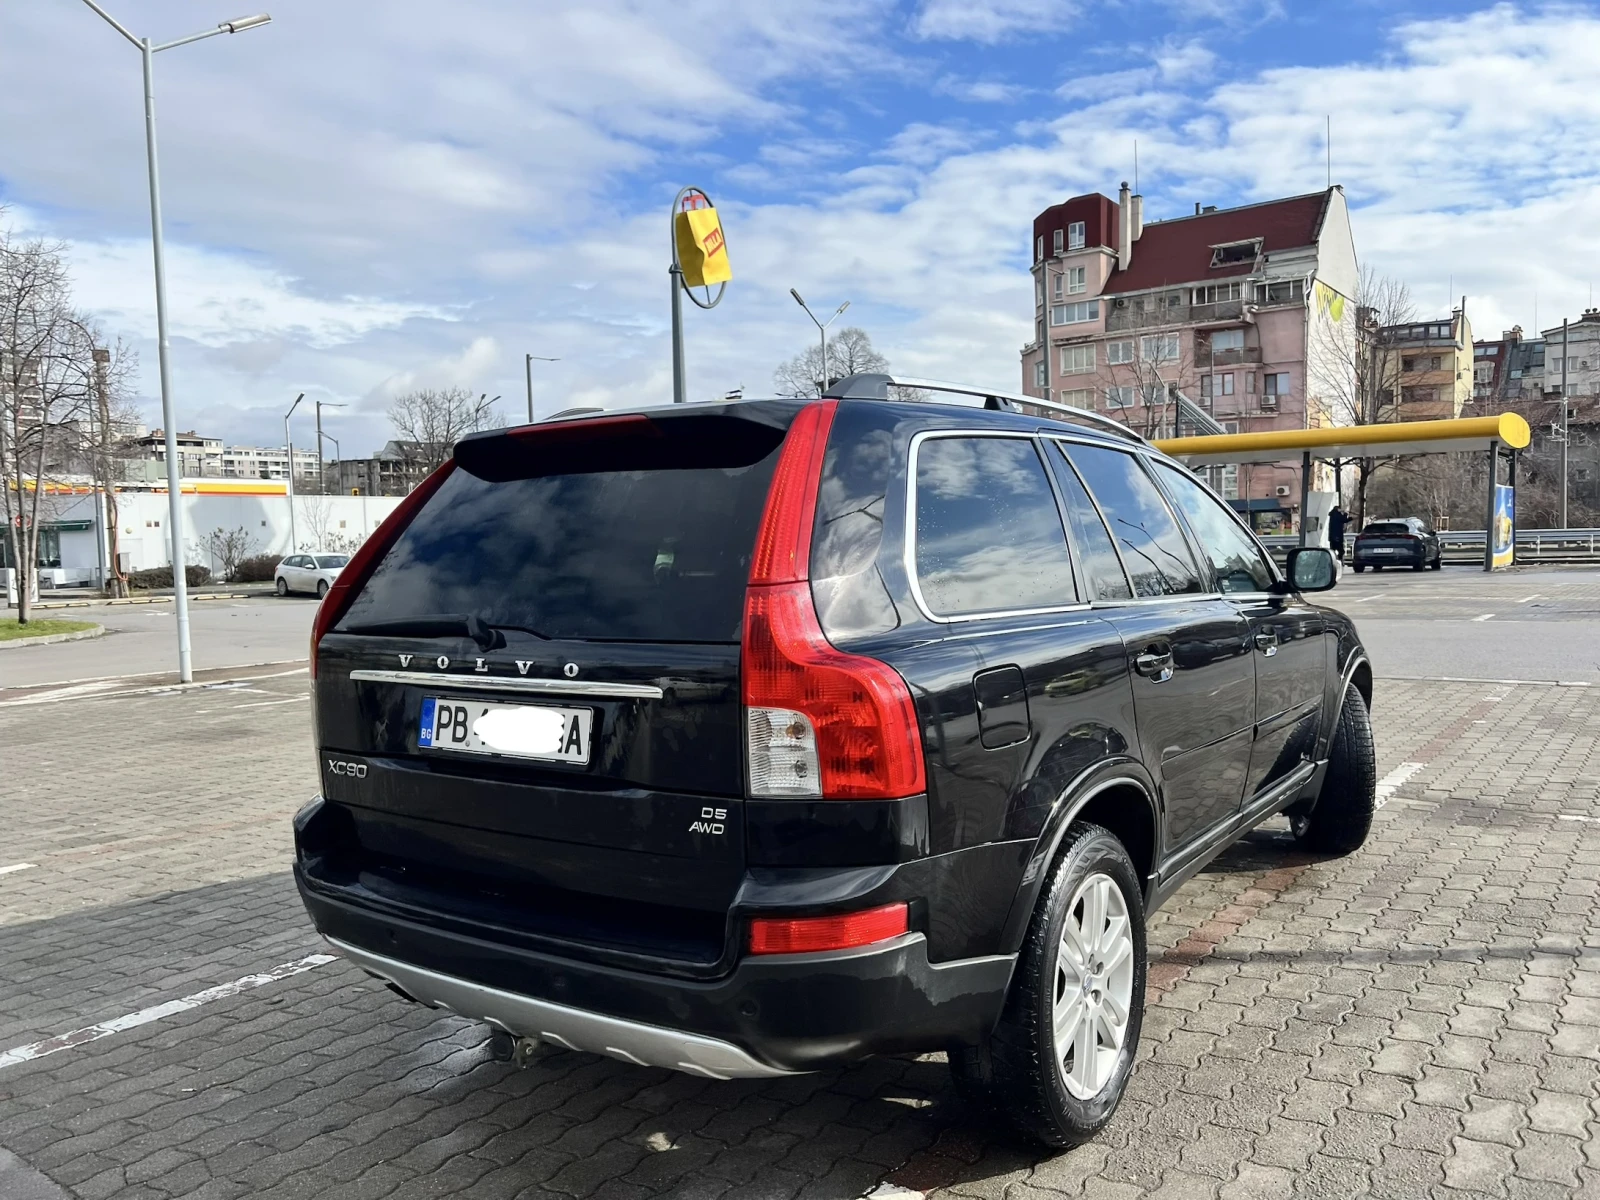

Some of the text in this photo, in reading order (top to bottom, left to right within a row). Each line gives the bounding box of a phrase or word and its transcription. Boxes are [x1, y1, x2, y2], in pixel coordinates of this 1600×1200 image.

[398, 654, 579, 678] VOLVO
[435, 704, 468, 743] PB
[420, 728, 432, 740] BG
[328, 759, 368, 779] XC90
[701, 807, 727, 820] D5
[688, 821, 725, 835] AWD
